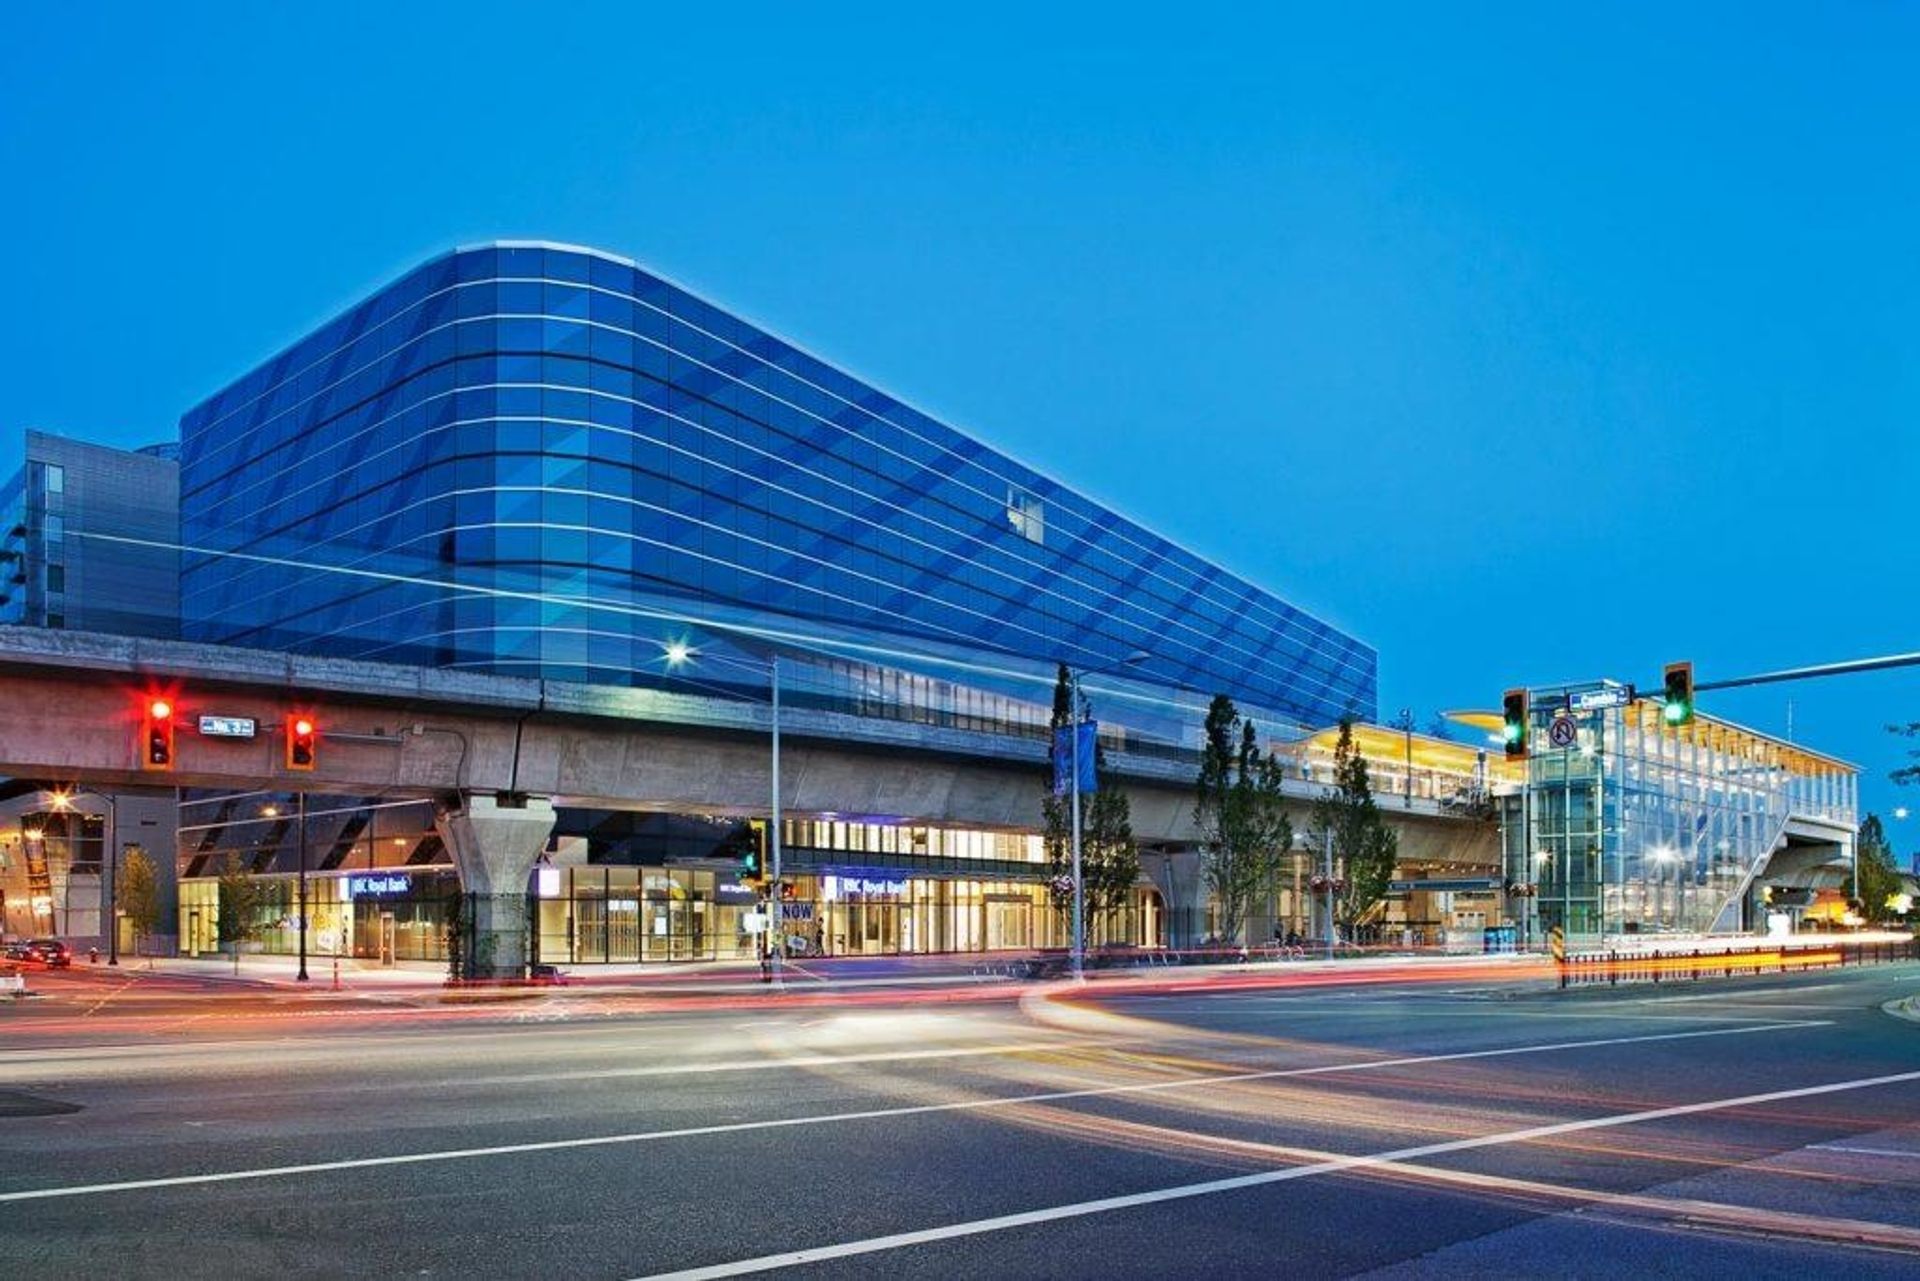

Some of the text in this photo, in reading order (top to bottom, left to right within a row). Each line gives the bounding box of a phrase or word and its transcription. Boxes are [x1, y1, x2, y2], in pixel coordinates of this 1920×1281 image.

[368, 877, 387, 896] Royal
[389, 877, 408, 892] Bank
[863, 877, 885, 897] Royal
[782, 904, 811, 918] NOW
